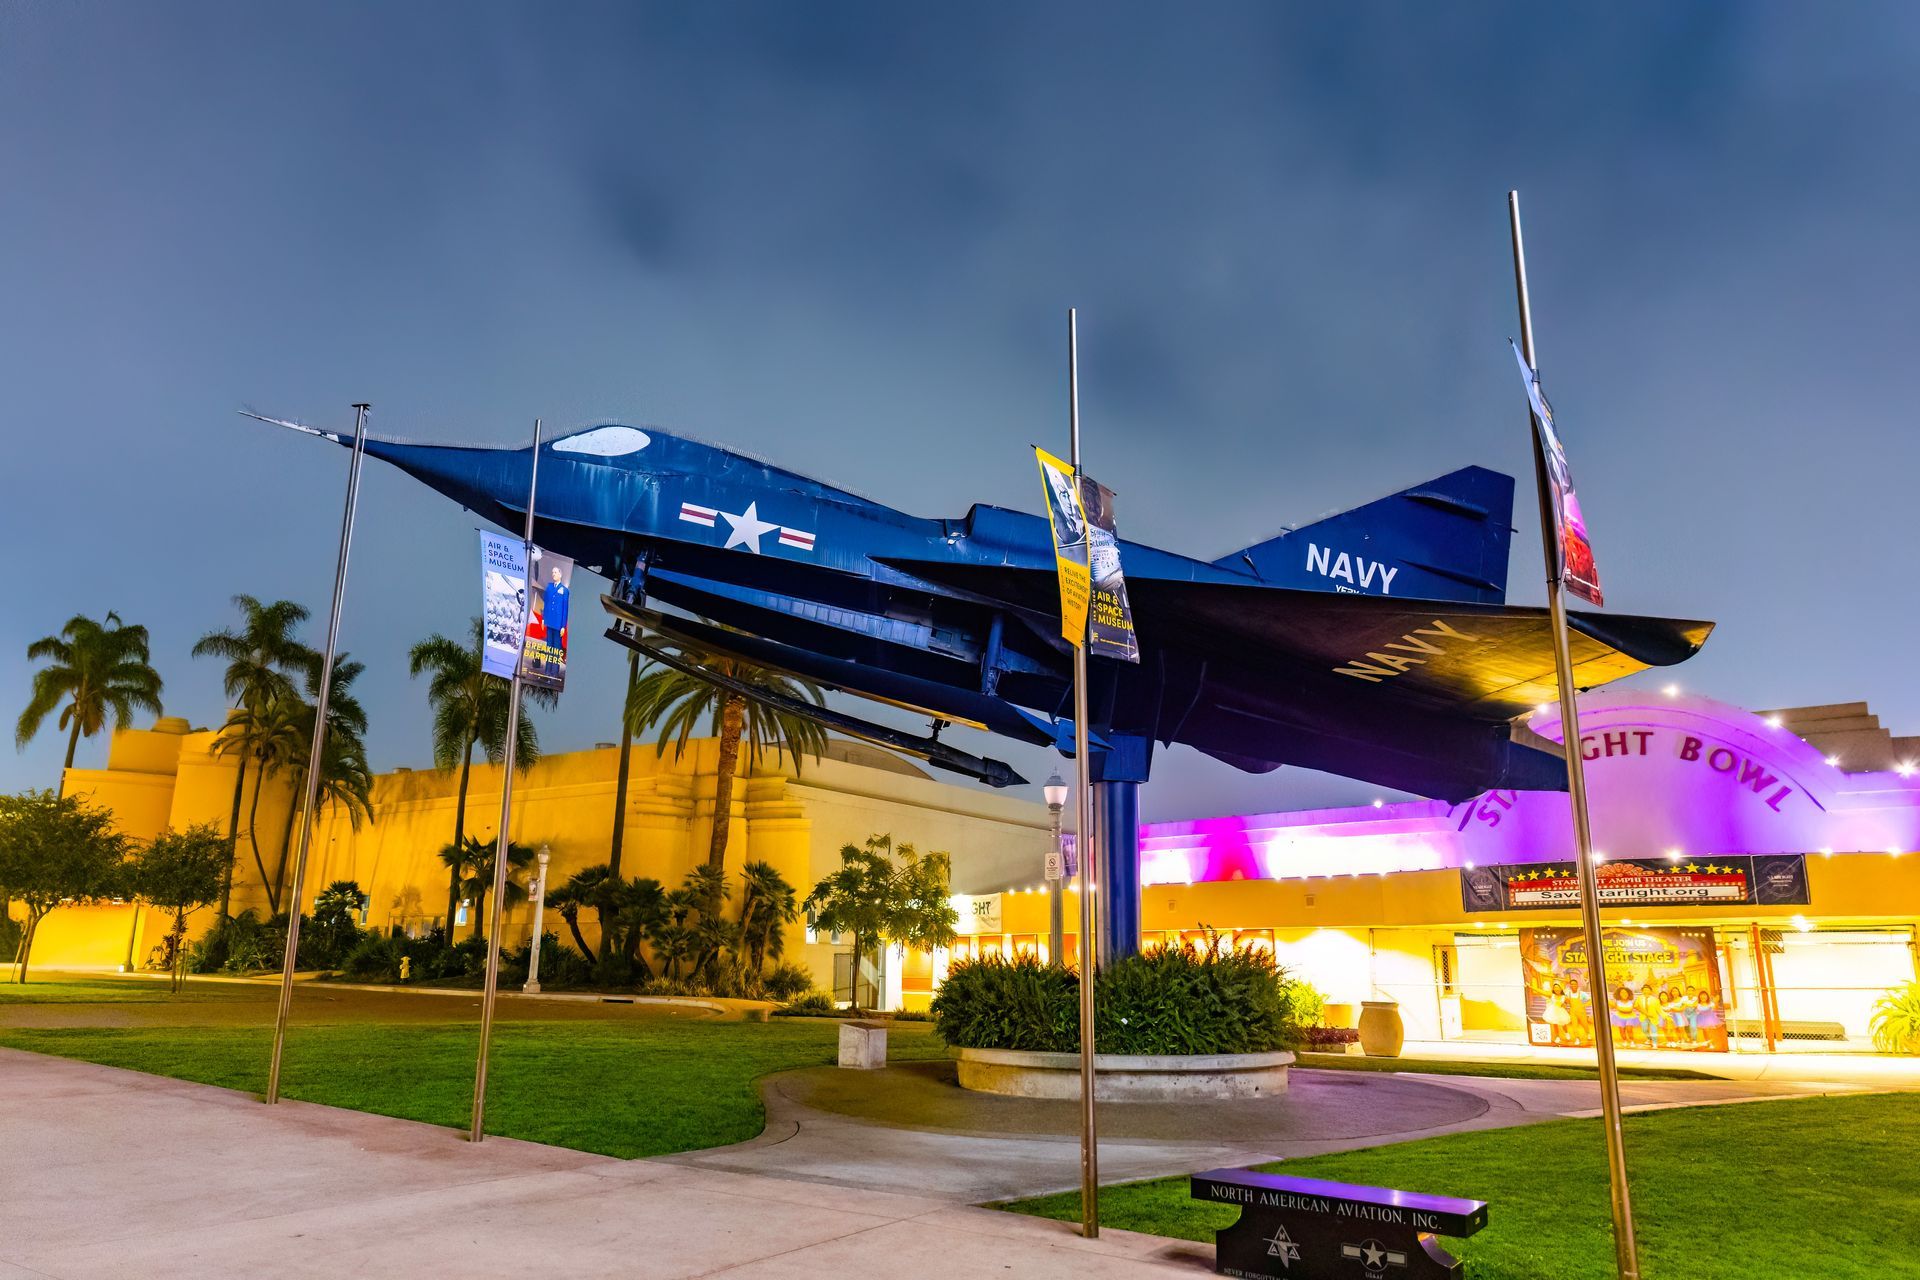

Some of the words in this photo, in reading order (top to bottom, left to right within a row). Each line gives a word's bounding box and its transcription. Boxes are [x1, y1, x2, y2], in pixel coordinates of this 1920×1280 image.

[488, 541, 501, 550] AIR
[504, 545, 509, 553] &
[489, 549, 514, 562] SPACE
[489, 558, 525, 573] MUSEUM
[1305, 542, 1398, 595] NAVY
[1097, 591, 1110, 603] AIR
[1112, 595, 1118, 605] &
[1097, 602, 1124, 617] SPACE
[1098, 614, 1133, 630] MUSEUM
[525, 640, 564, 657] BREAKING
[1332, 619, 1479, 683] NAVY
[523, 649, 562, 664] BARRIERS
[1679, 736, 1793, 813] BOWL
[1541, 887, 1709, 899] Savetarlight.org
[1565, 951, 1631, 963] STAGHT
[1632, 952, 1672, 963] STAGE
[1211, 1184, 1254, 1203] NORTH
[1260, 1192, 1330, 1213] AMERICAN
[1412, 1212, 1442, 1230] INC.
